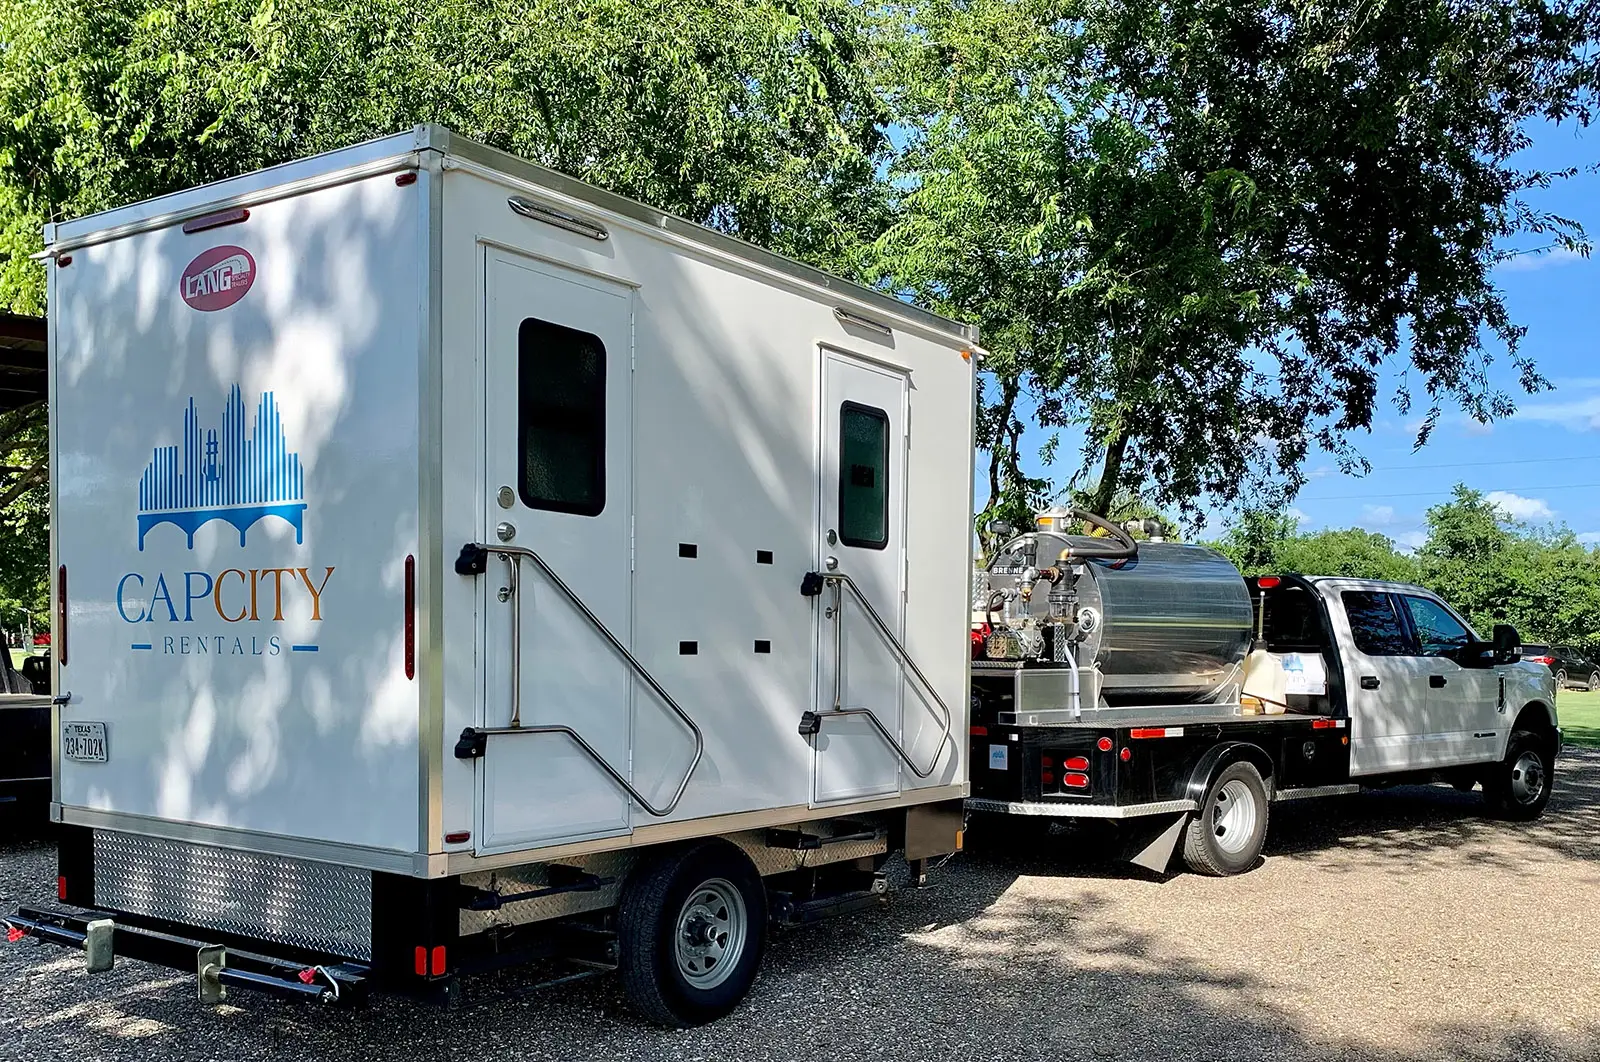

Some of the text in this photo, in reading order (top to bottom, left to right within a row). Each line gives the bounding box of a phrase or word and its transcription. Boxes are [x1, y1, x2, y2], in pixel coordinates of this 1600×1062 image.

[185, 266, 231, 299] LANG
[993, 566, 1023, 574] BRENNE
[116, 566, 336, 624] CAPCITY
[163, 635, 281, 656] RENTALS
[74, 725, 91, 734] TEXAS
